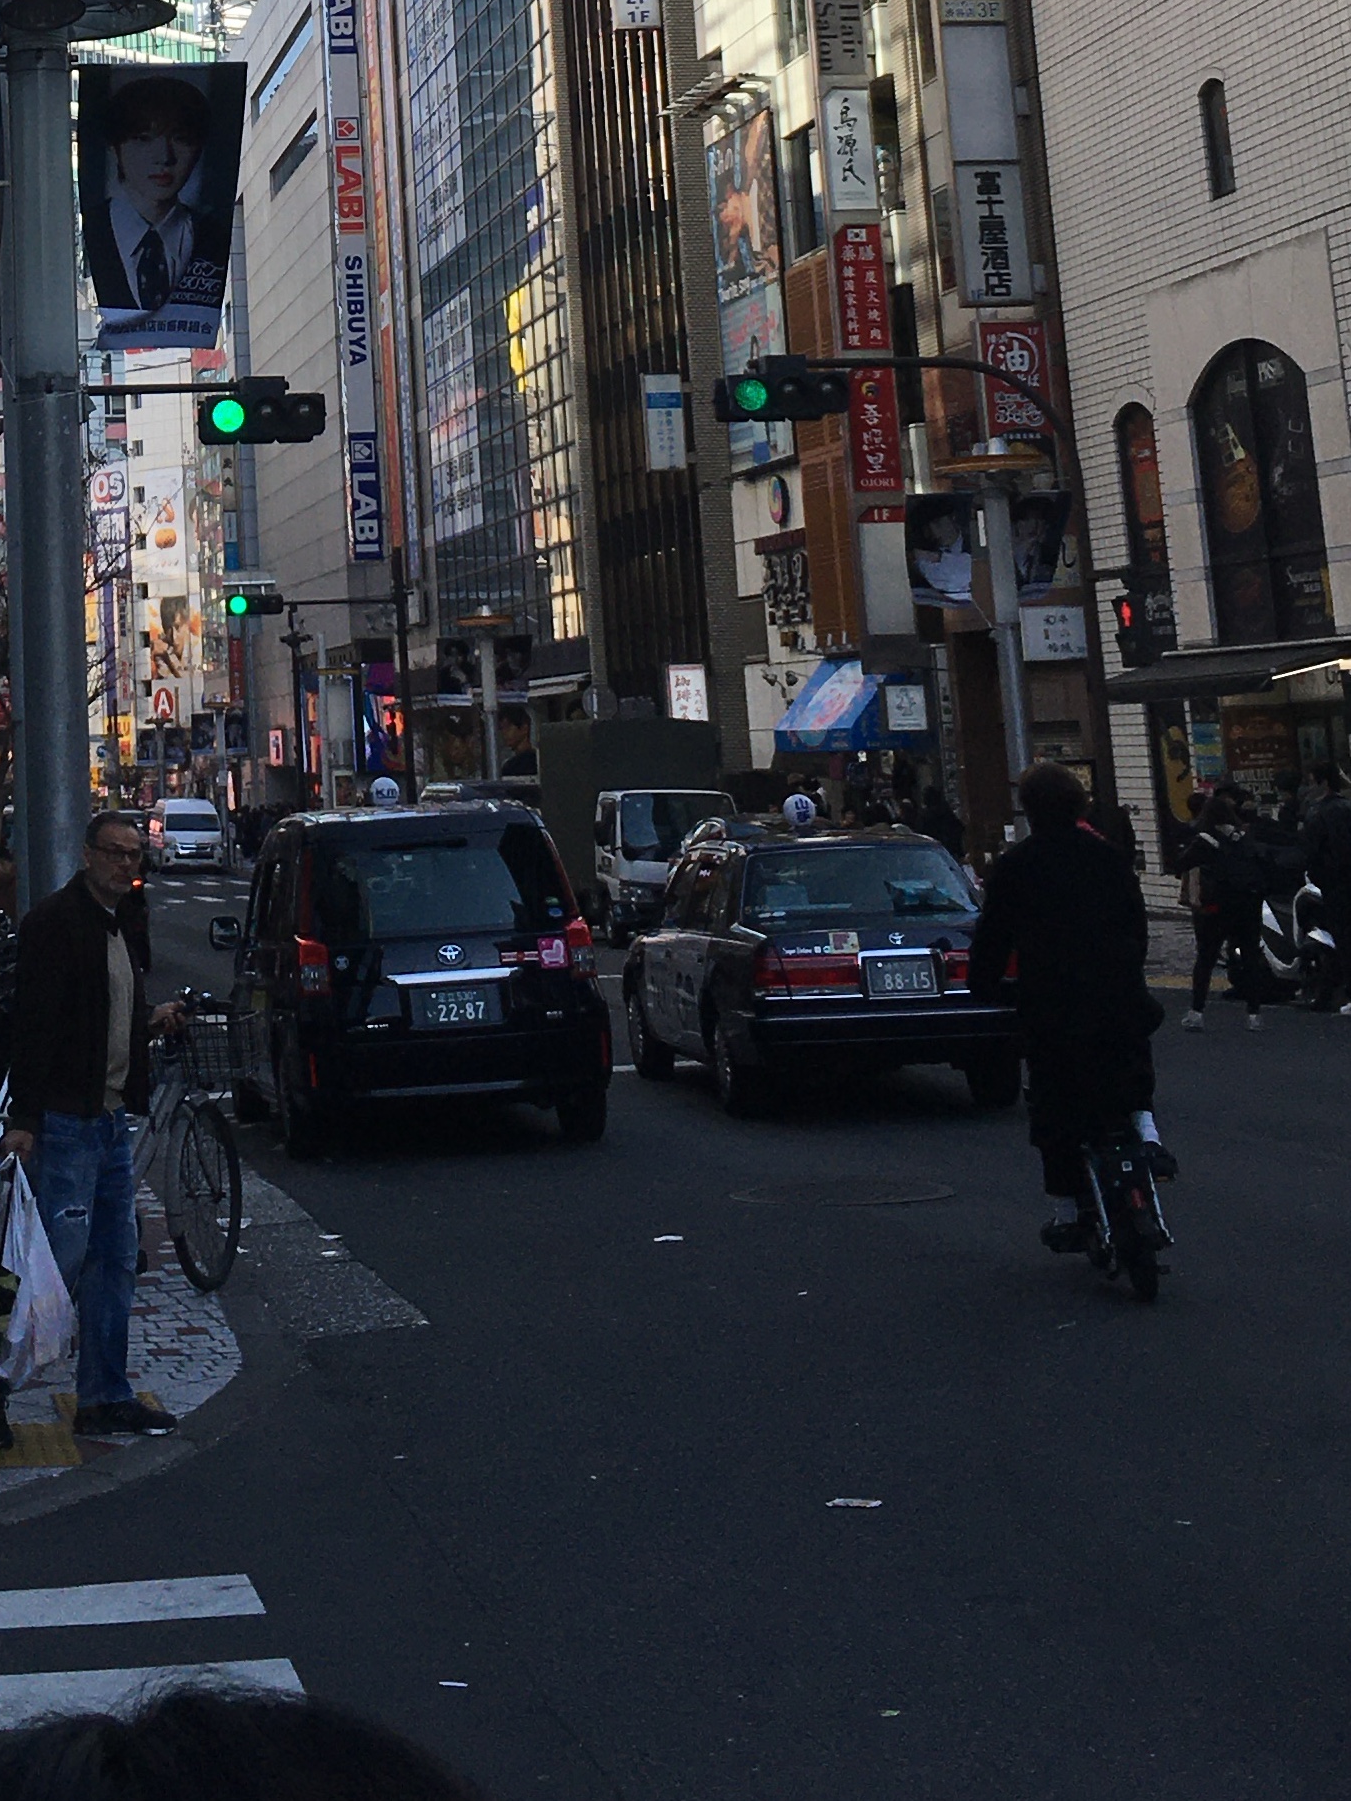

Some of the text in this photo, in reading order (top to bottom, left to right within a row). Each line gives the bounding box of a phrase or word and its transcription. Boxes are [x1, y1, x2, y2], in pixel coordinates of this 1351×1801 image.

[628, 11, 650, 23] 1F
[977, 2, 999, 18] 3F
[816, 2, 838, 71] Salon
[839, 4, 863, 59] Hair
[335, 146, 367, 235] LABI
[975, 171, 1011, 297] 富士屋酒店
[344, 255, 368, 367] SHIBUYA
[95, 471, 126, 502] OS
[860, 477, 896, 487] OJORI
[352, 473, 382, 557] LABI
[873, 509, 891, 520] 1F
[883, 972, 931, 990] 88-15
[438, 1001, 485, 1022] 22-87
